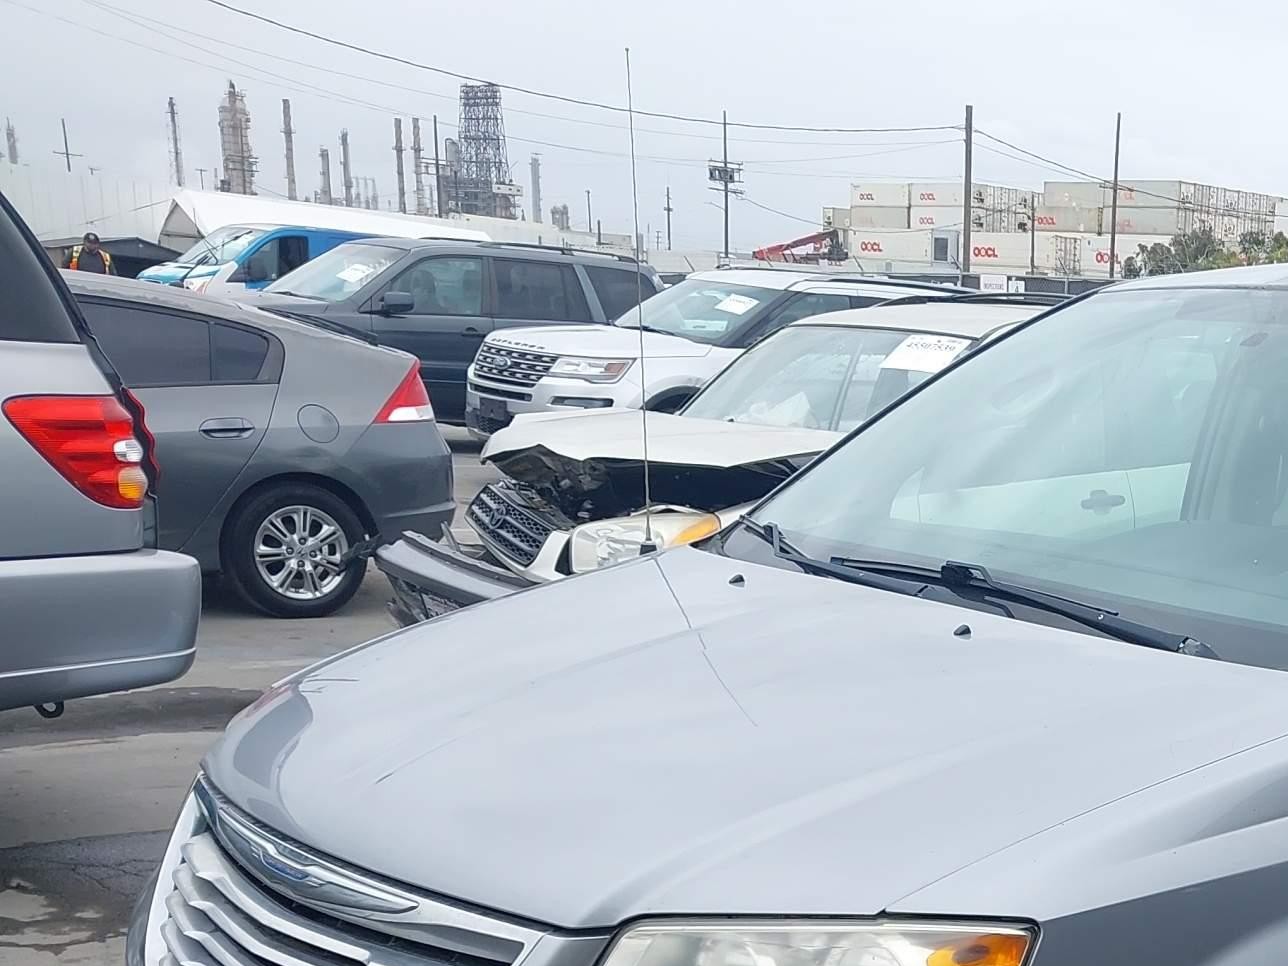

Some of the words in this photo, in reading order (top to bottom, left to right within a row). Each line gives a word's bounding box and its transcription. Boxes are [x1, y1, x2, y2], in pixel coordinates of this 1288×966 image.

[859, 192, 875, 201] OOCL
[919, 192, 936, 201] OOCL
[919, 216, 935, 225] OOCL
[860, 241, 883, 252] OOCL
[973, 246, 998, 258] OOCL
[1095, 250, 1121, 263] OOL
